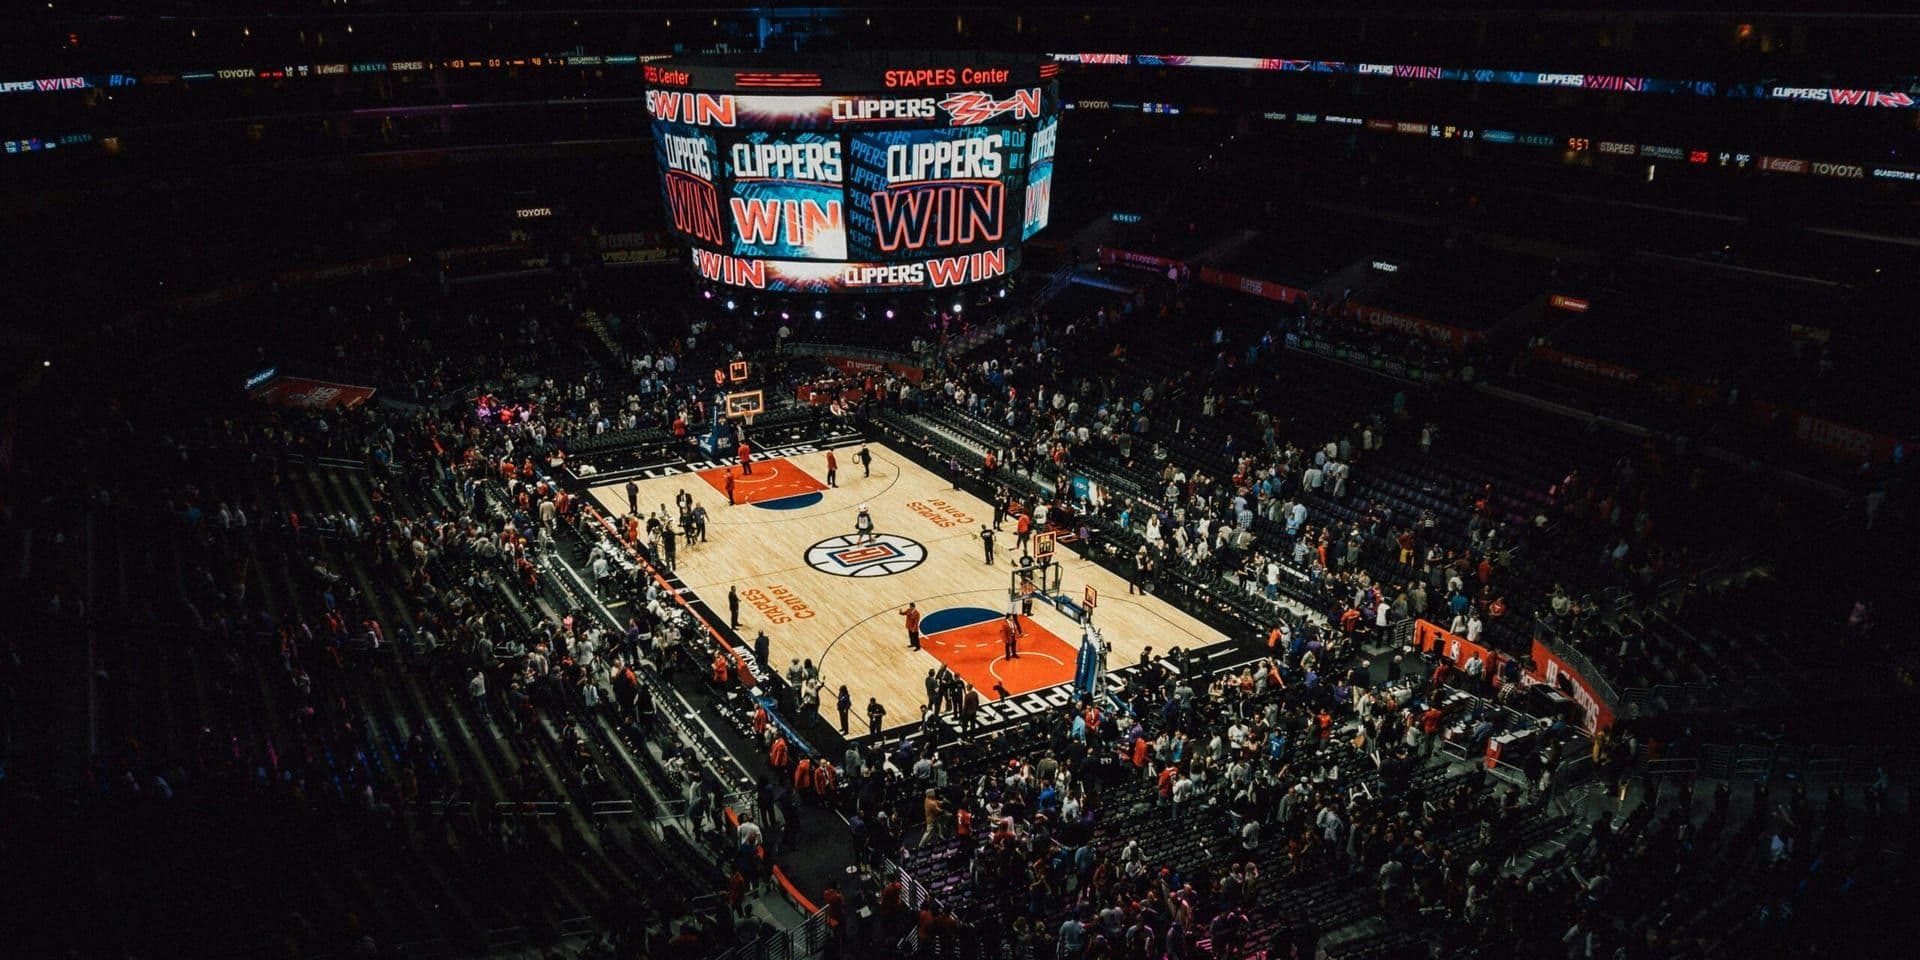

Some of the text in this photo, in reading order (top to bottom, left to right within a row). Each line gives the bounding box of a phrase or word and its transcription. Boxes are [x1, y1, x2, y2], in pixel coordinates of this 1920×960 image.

[392, 63, 423, 71] STAPLES
[1080, 53, 1128, 64] WIN
[217, 69, 256, 79] TOYOTA
[658, 67, 689, 85] Center
[884, 67, 1010, 88] STAPLES Center
[1358, 64, 1442, 80] CLIPPERS WIN
[1537, 73, 1644, 92] CLIPPERS WIN
[35, 77, 85, 91] WIN
[1771, 86, 1829, 101] CLIPPERS
[652, 90, 737, 127] WIN
[831, 97, 937, 120] CLIPPERS
[1077, 100, 1110, 110] TOYOTA
[1029, 119, 1058, 166] CLIPPERS
[1527, 135, 1554, 144] DELTA
[1599, 141, 1636, 155] STAPLES
[664, 133, 712, 182] CLIPPERS
[732, 141, 844, 183] CLIPPERS
[887, 134, 1003, 183] CLIPPERS
[1811, 162, 1864, 179] TOYOTA
[665, 171, 723, 246] WIN
[1024, 174, 1053, 229] WIN
[516, 208, 552, 218] TOYOTA
[730, 197, 844, 245] WIN
[871, 184, 1005, 253] WIN
[698, 248, 766, 290] WIN
[846, 264, 925, 284] CLIPPERS
[926, 247, 1006, 288] WIN
[1371, 259, 1399, 273] verizon
[643, 465, 684, 480] LA
[905, 500, 956, 529] STAPLES
[927, 498, 976, 524] Center
[740, 588, 794, 625] STAPLES
[767, 584, 817, 619] Center
